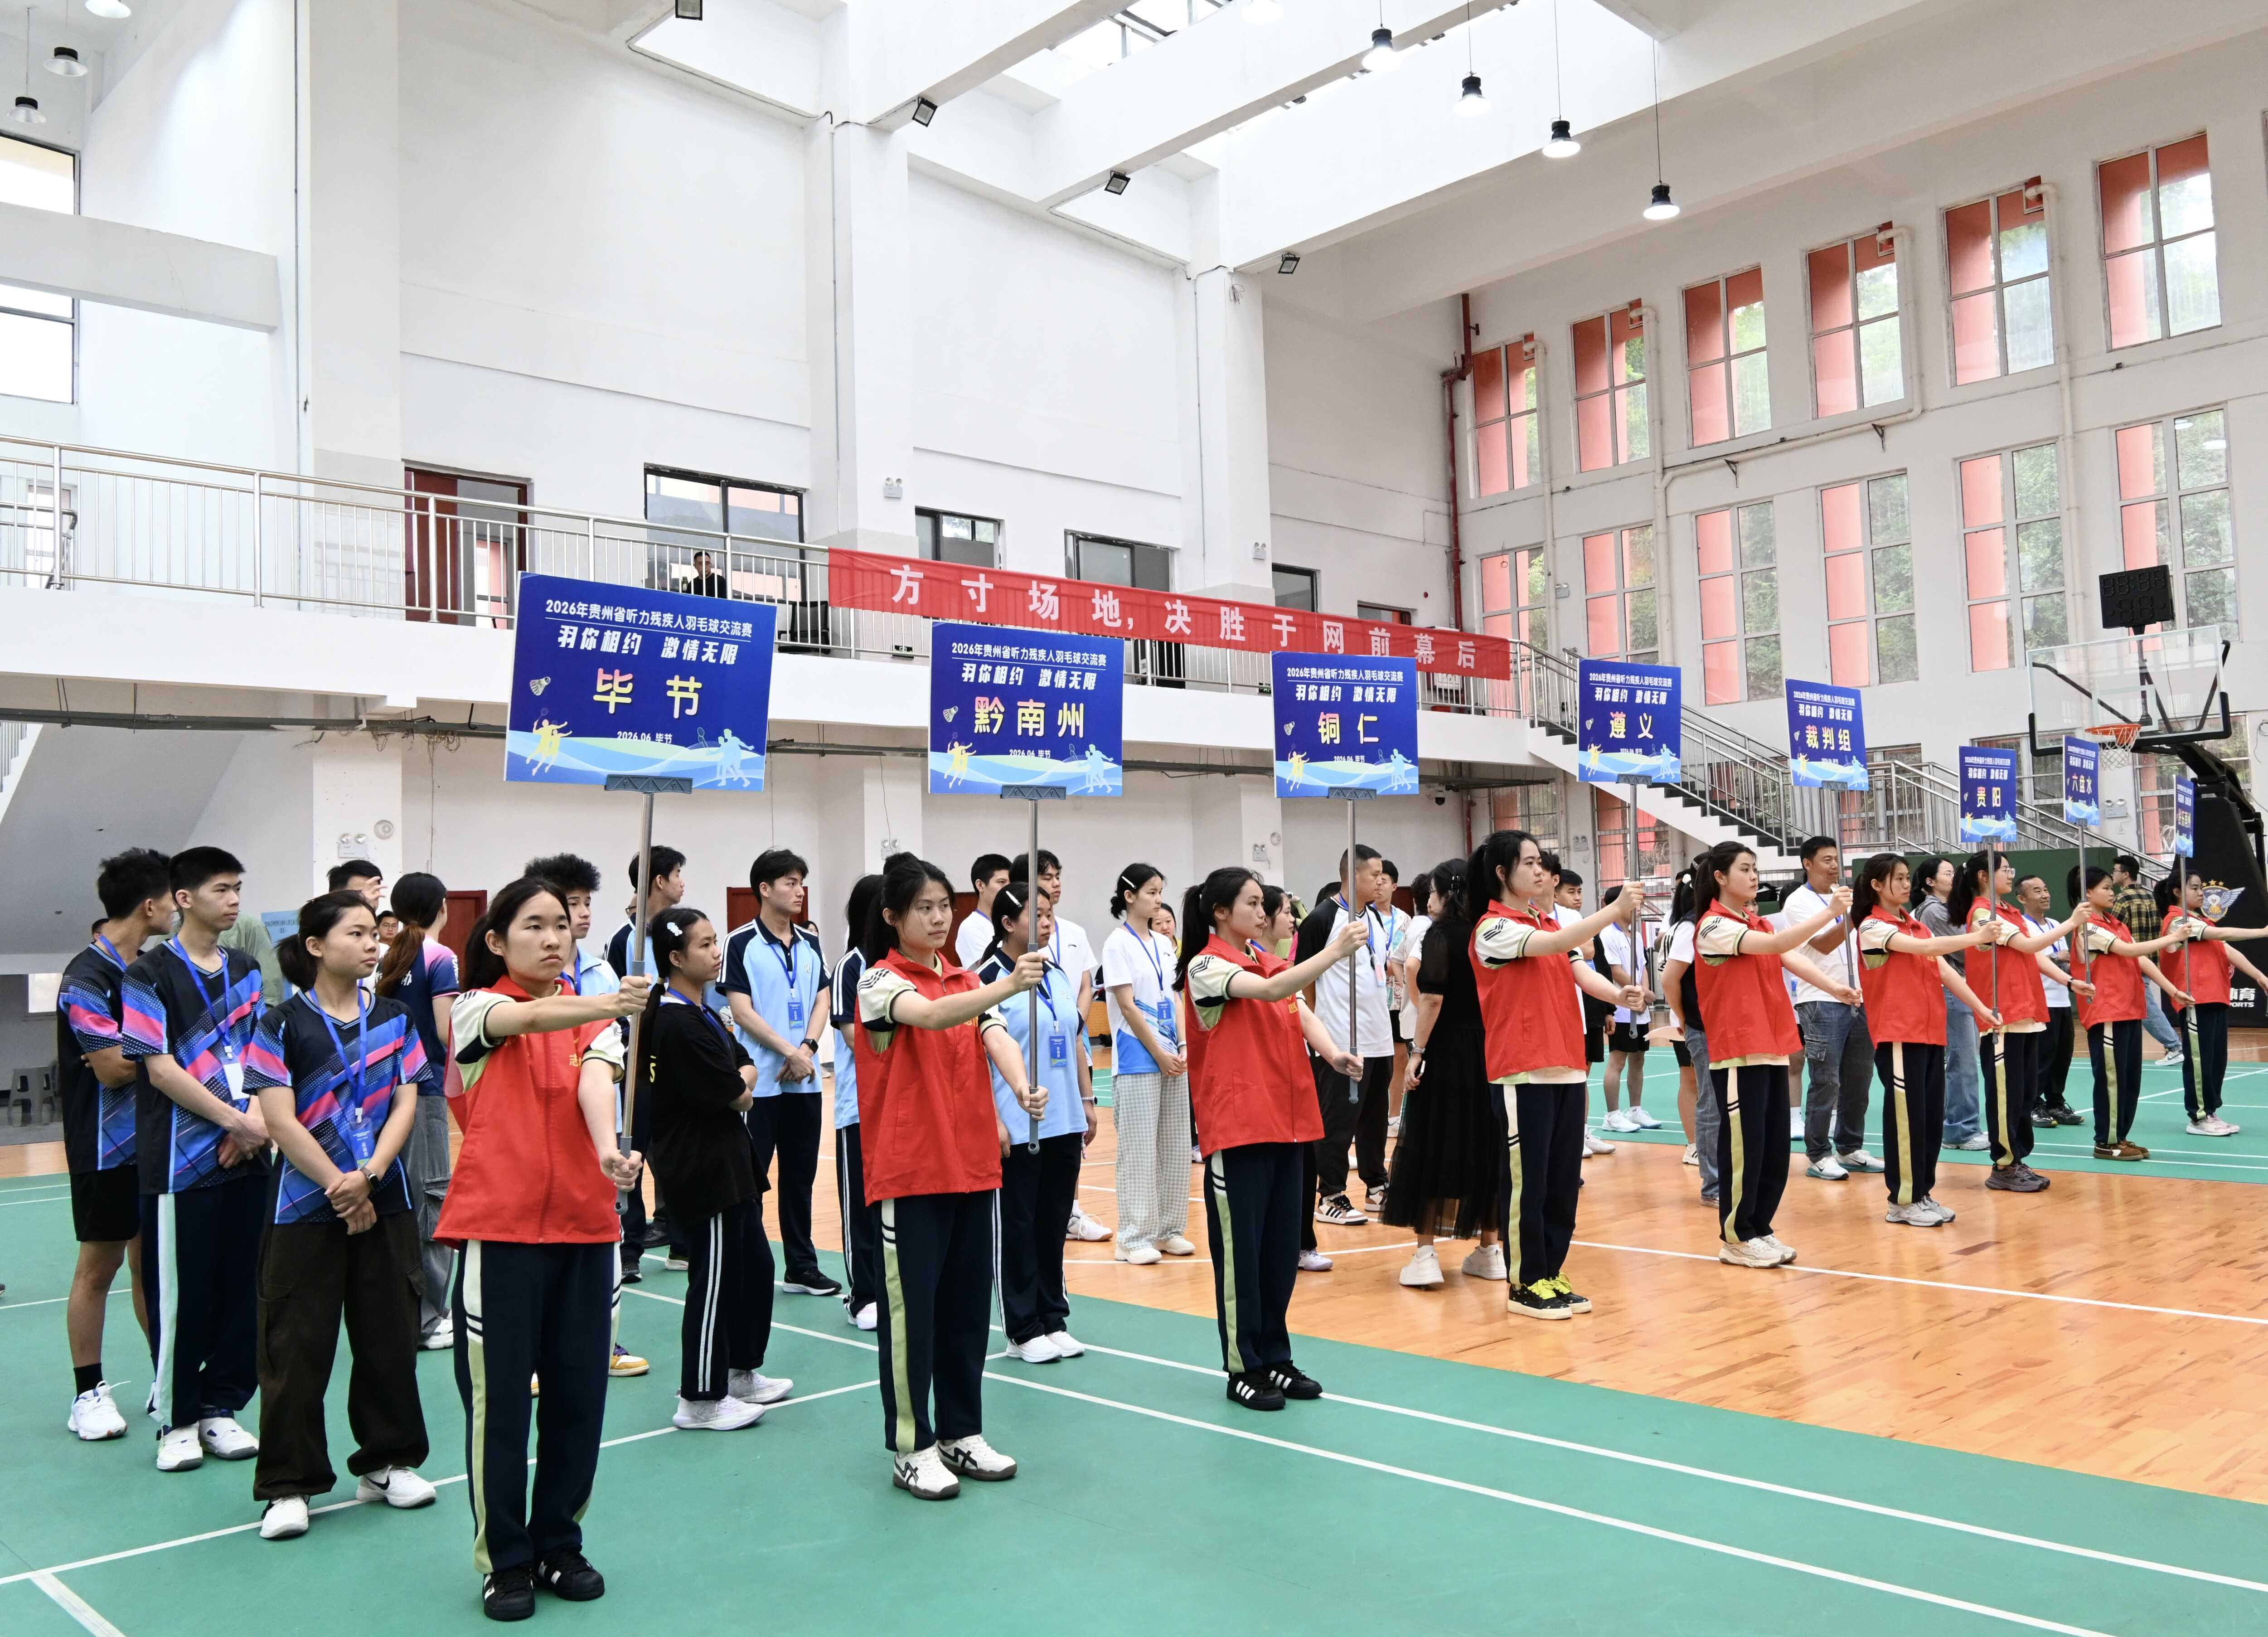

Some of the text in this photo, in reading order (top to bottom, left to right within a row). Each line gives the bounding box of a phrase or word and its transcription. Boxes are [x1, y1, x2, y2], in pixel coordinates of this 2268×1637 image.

[545, 599, 753, 638] 2026年贵州省听力残疾人羽毛球交流赛
[557, 624, 739, 665] 羽你相约 激情无限
[952, 642, 1106, 667] 2026年贵州省听力残疾人羽毛球交流赛
[961, 663, 1097, 690] 羽你相约 激情无限
[1287, 667, 1404, 682] 2026年贵州省听力残疾人羽毛球交流赛
[593, 667, 703, 719] 毕节
[1295, 684, 1397, 703] 羽你相约 激情无限
[974, 696, 1084, 738] 黔南州
[1318, 711, 1379, 744] 铜仁
[1609, 711, 1653, 739] 遵义
[617, 731, 673, 744] 2026.06 毕节
[1805, 724, 1851, 752] 裁判组
[1038, 749, 1051, 759] 毕节
[1977, 787, 2001, 807] 贵阳
